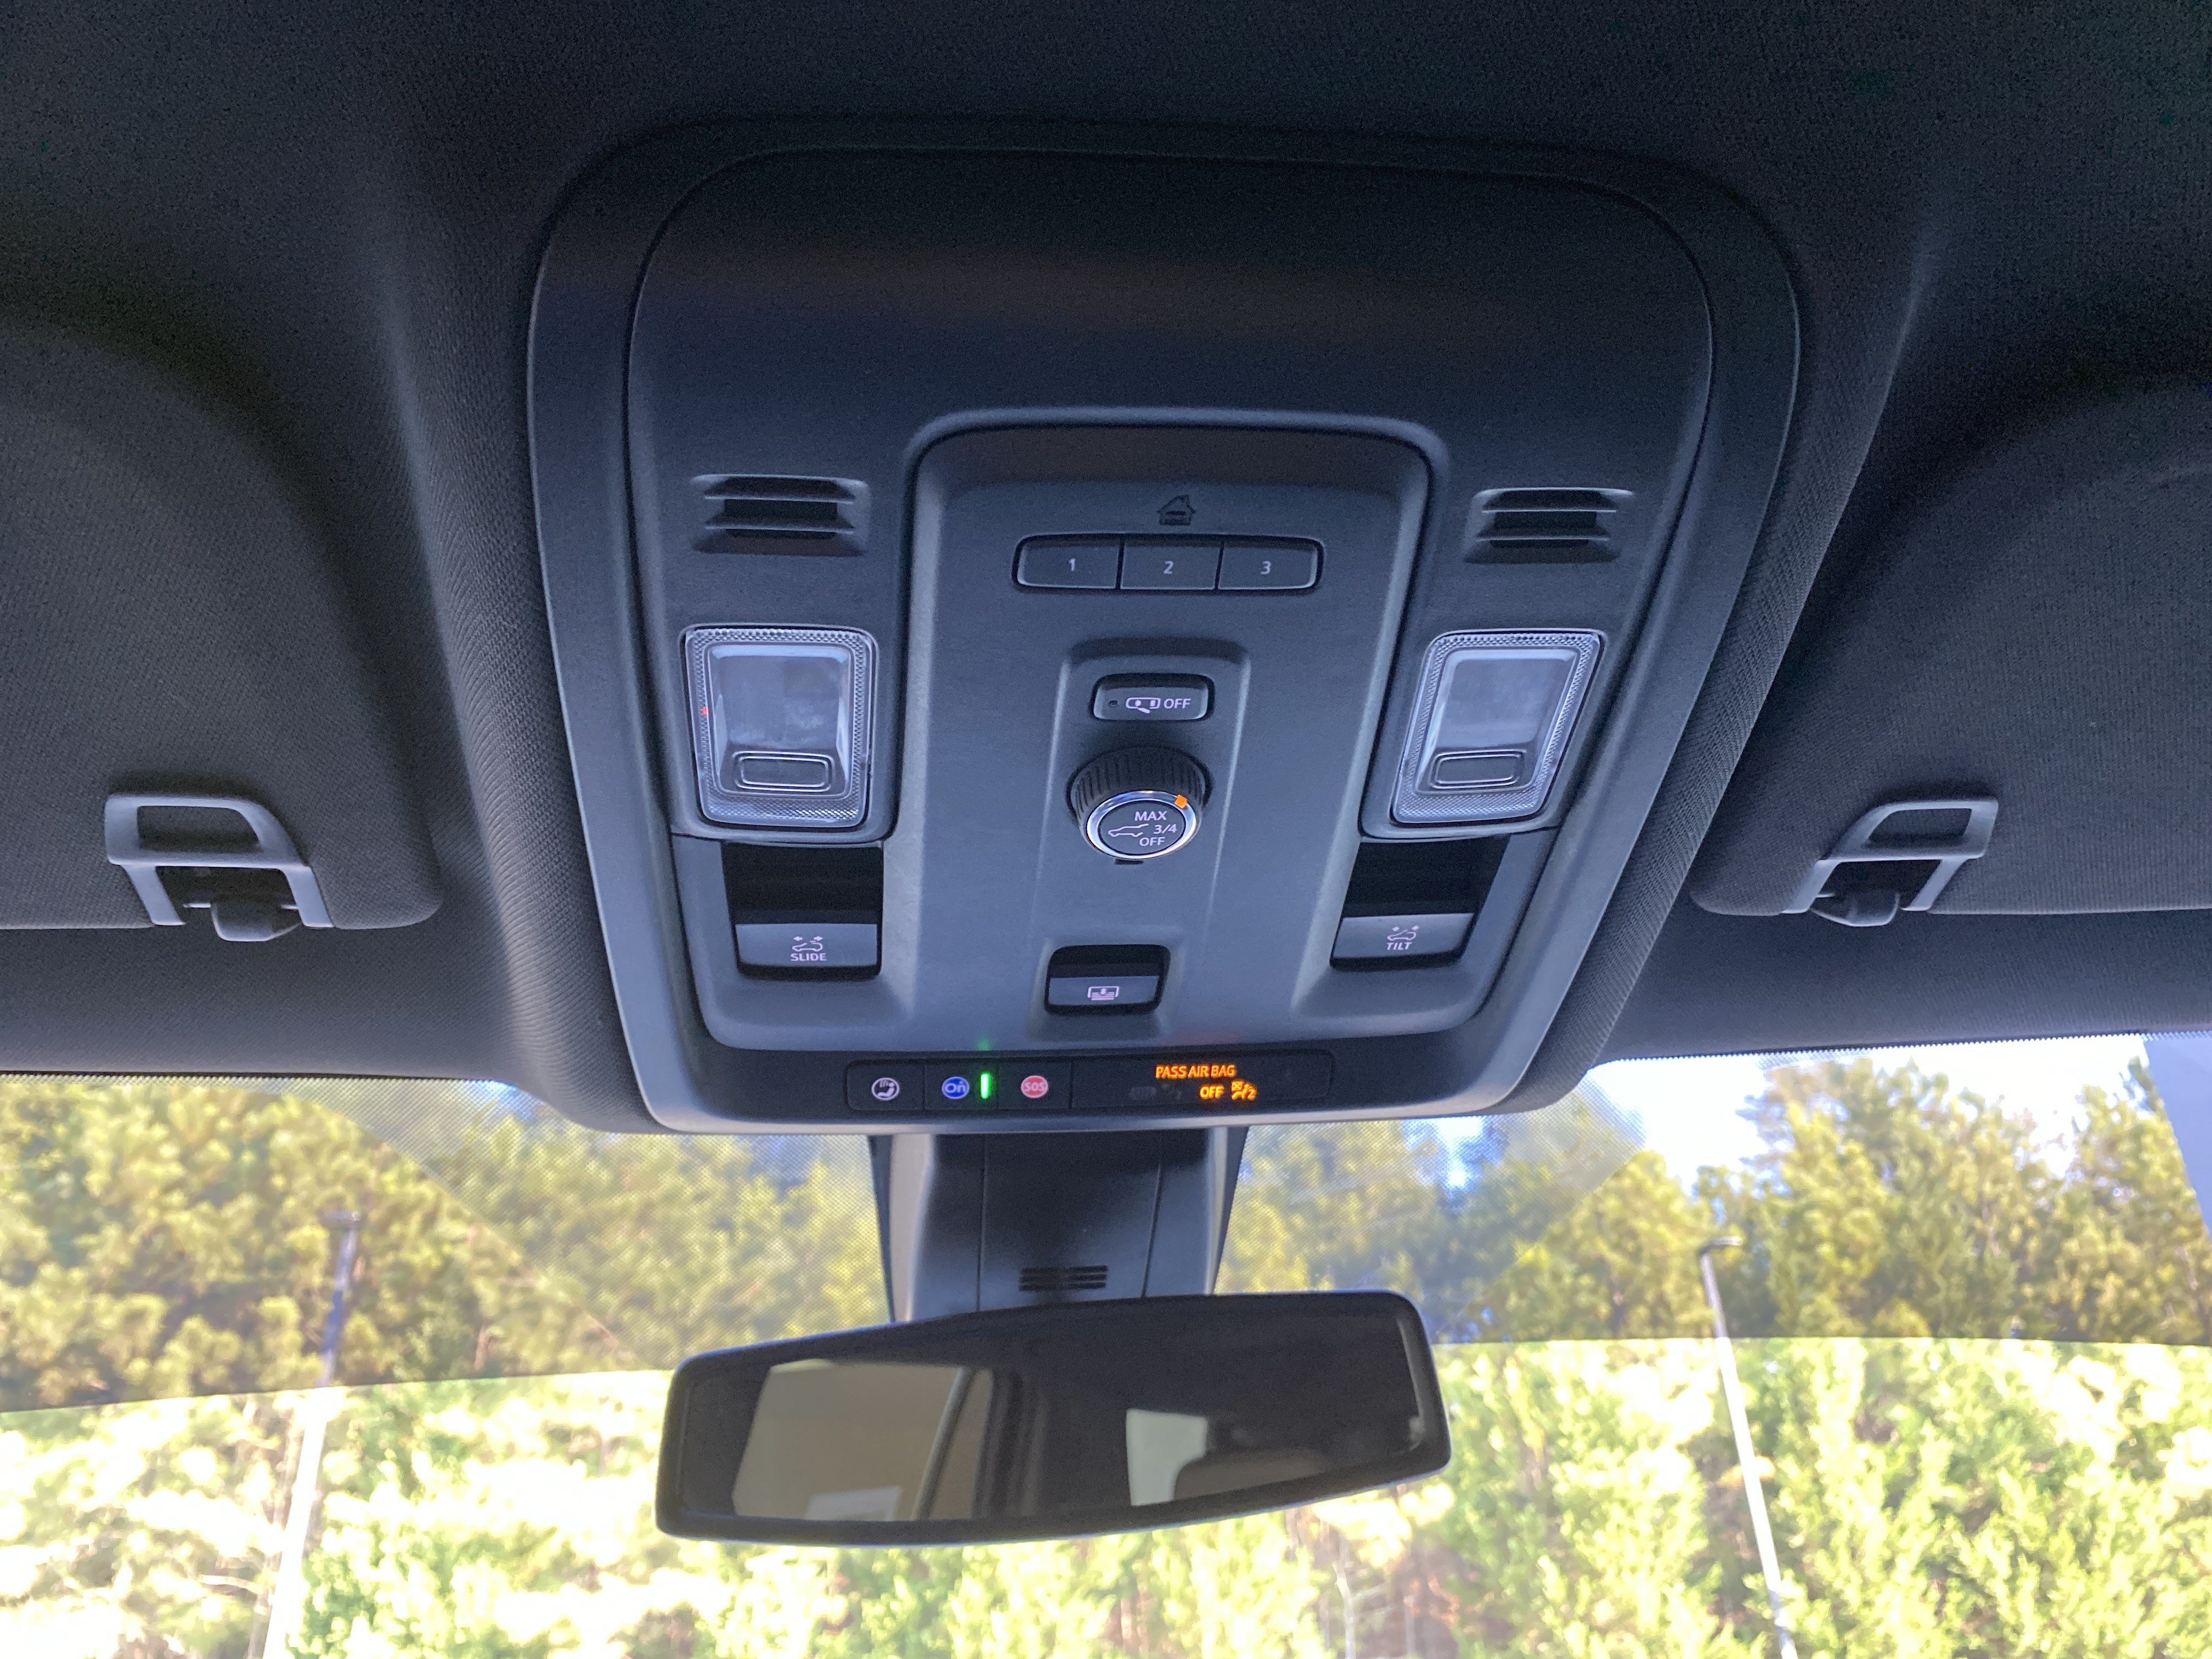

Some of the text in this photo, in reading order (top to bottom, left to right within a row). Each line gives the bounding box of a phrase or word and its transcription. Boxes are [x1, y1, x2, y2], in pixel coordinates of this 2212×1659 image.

[1069, 558, 1076, 571] 1
[1164, 561, 1174, 574] 2
[1261, 561, 1271, 575] 3
[1164, 698, 1192, 709] OFF
[1134, 810, 1167, 821] MAX
[1153, 823, 1177, 834] 3/4
[1139, 837, 1166, 847] OFF
[1386, 941, 1413, 950] TILT
[790, 952, 827, 962] SLIDE
[1155, 1064, 1236, 1079] PASS AIR BAG
[1024, 1081, 1046, 1092] SOS
[1199, 1085, 1225, 1099] OFF
